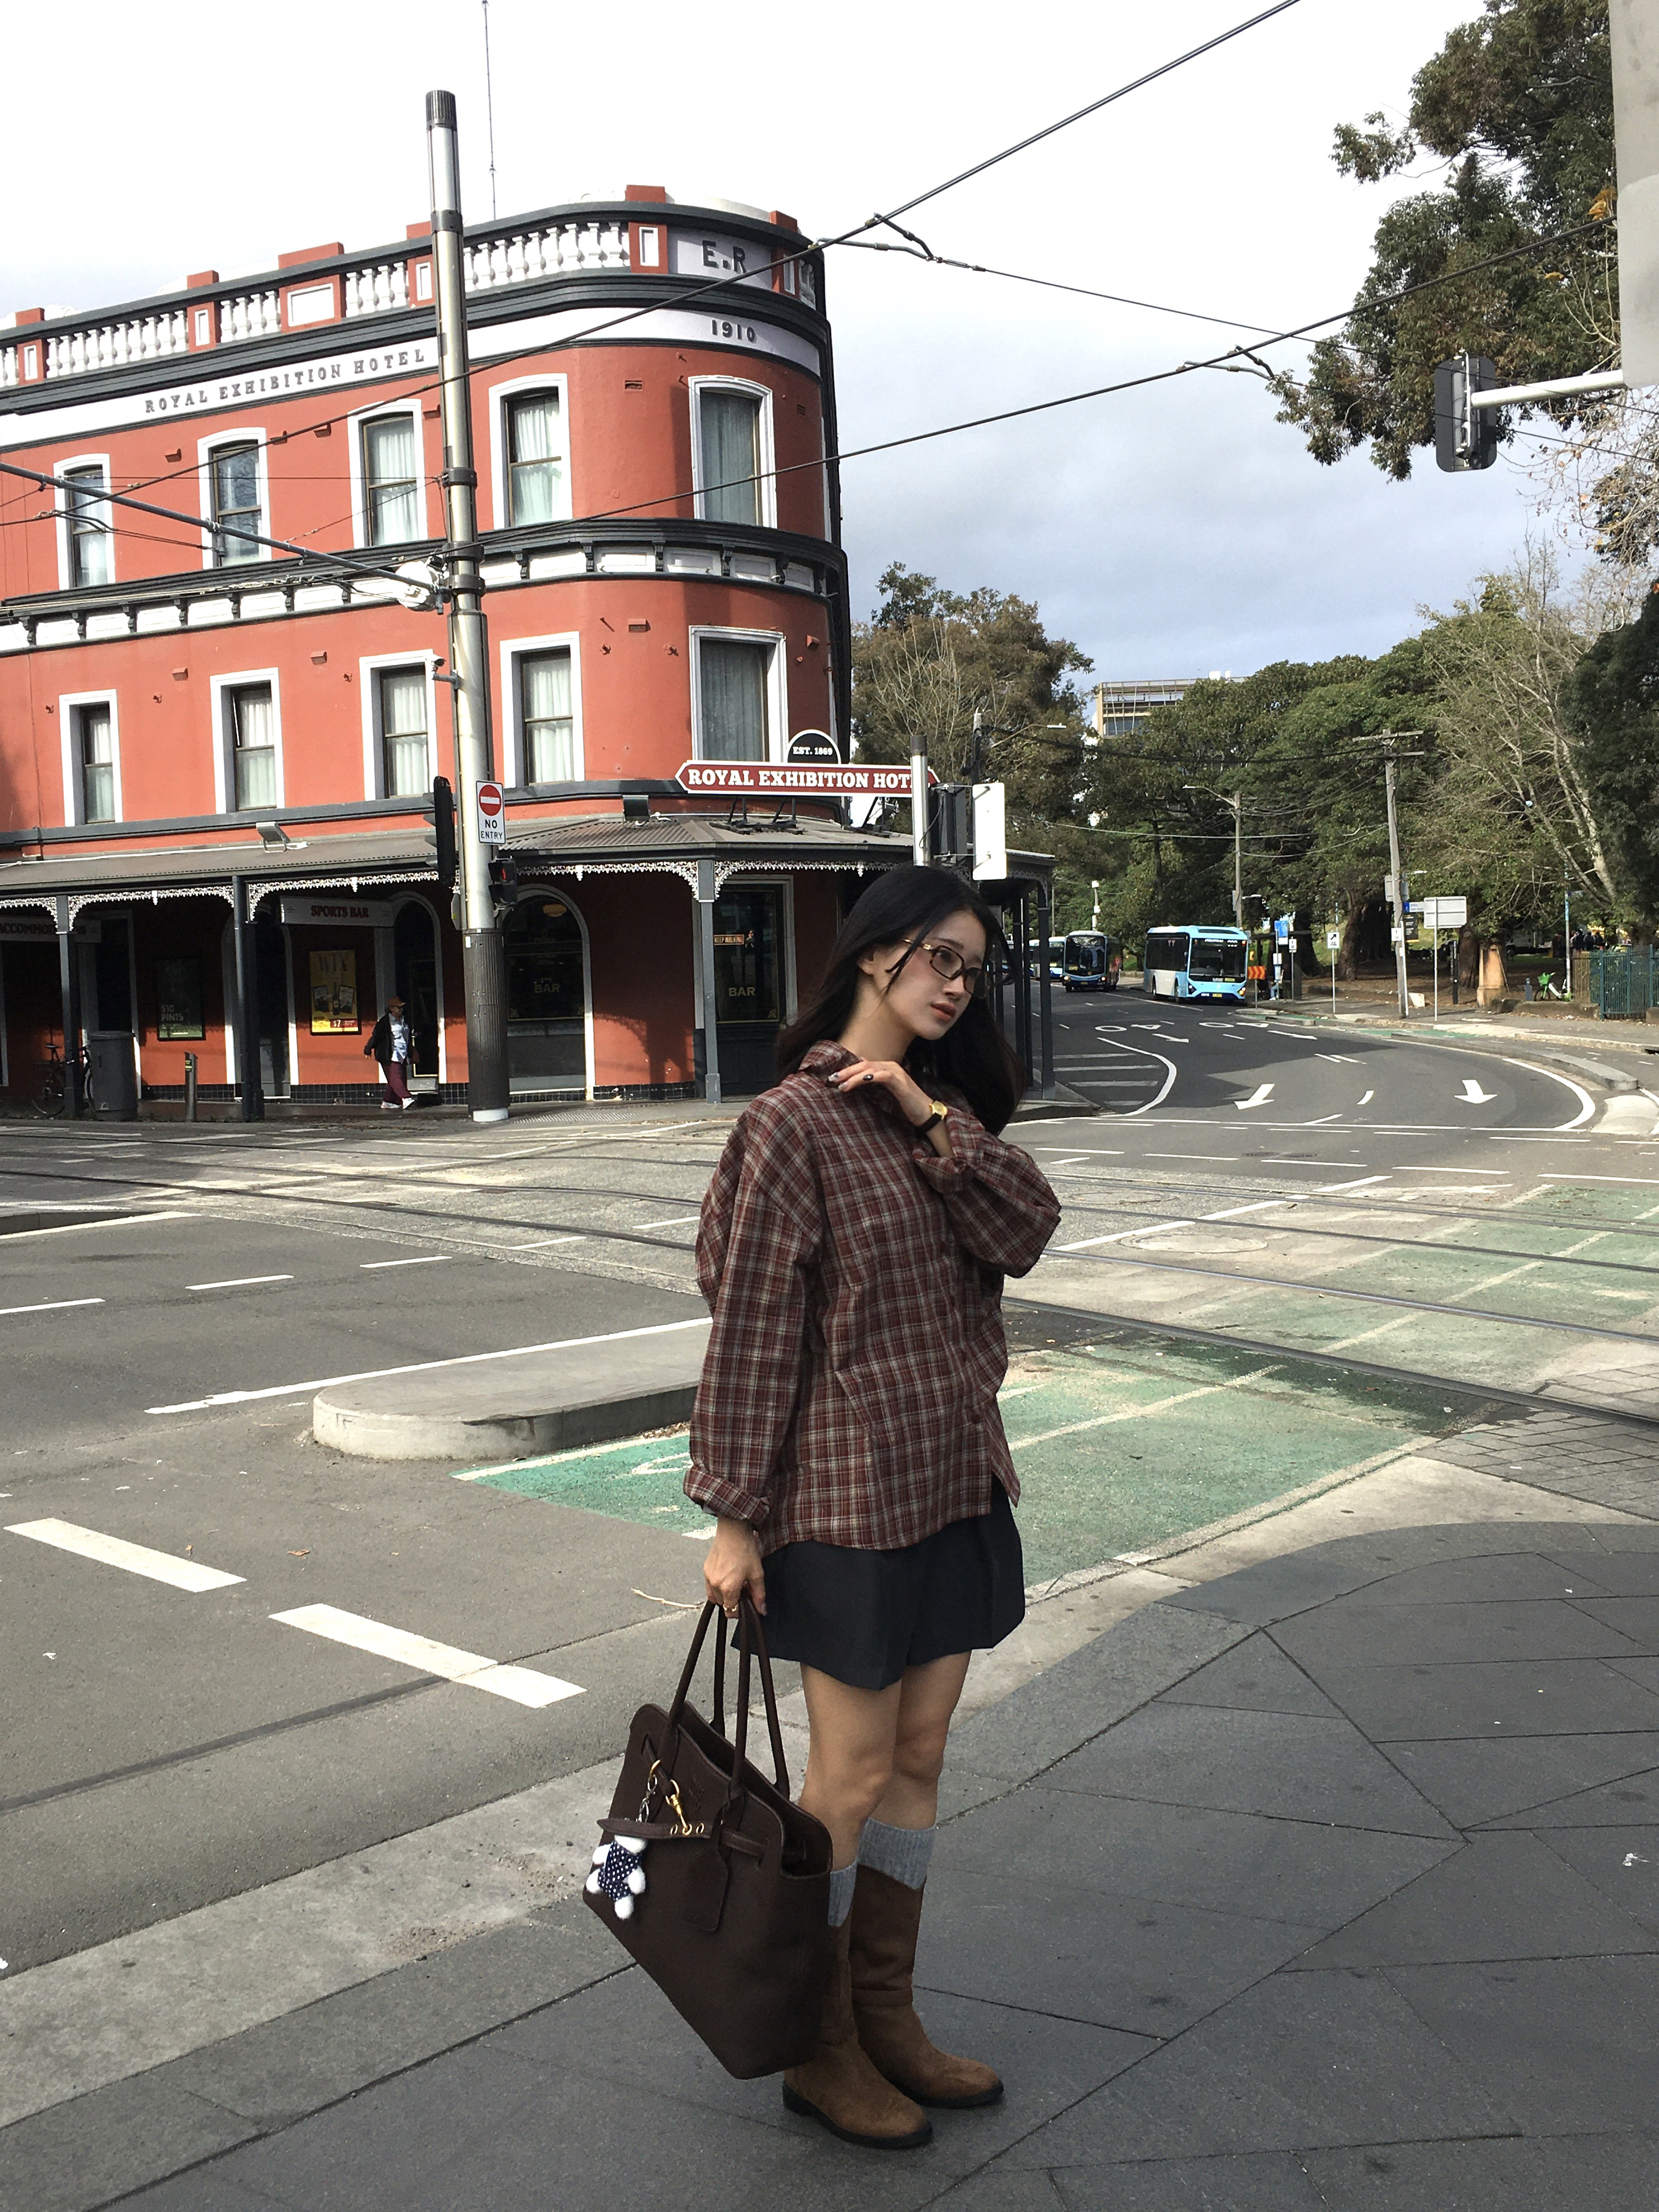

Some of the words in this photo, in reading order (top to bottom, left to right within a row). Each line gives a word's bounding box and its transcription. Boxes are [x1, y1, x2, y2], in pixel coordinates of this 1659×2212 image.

[712, 319, 755, 342] 1910
[145, 390, 208, 413] ROYAL
[219, 364, 341, 399] EXHIBITION
[354, 349, 425, 374] HOTEL
[793, 747, 812, 755] EST.
[814, 747, 833, 755] 1869
[688, 769, 754, 786] ROYAL
[758, 770, 870, 788] EXHIBITION
[873, 773, 930, 789] HOT
[485, 819, 497, 829] NO
[481, 831, 503, 839] ENTRY
[311, 905, 348, 918] SPORTS
[349, 906, 369, 919] BAR
[534, 983, 560, 993] BAR
[729, 986, 755, 997] BAR
